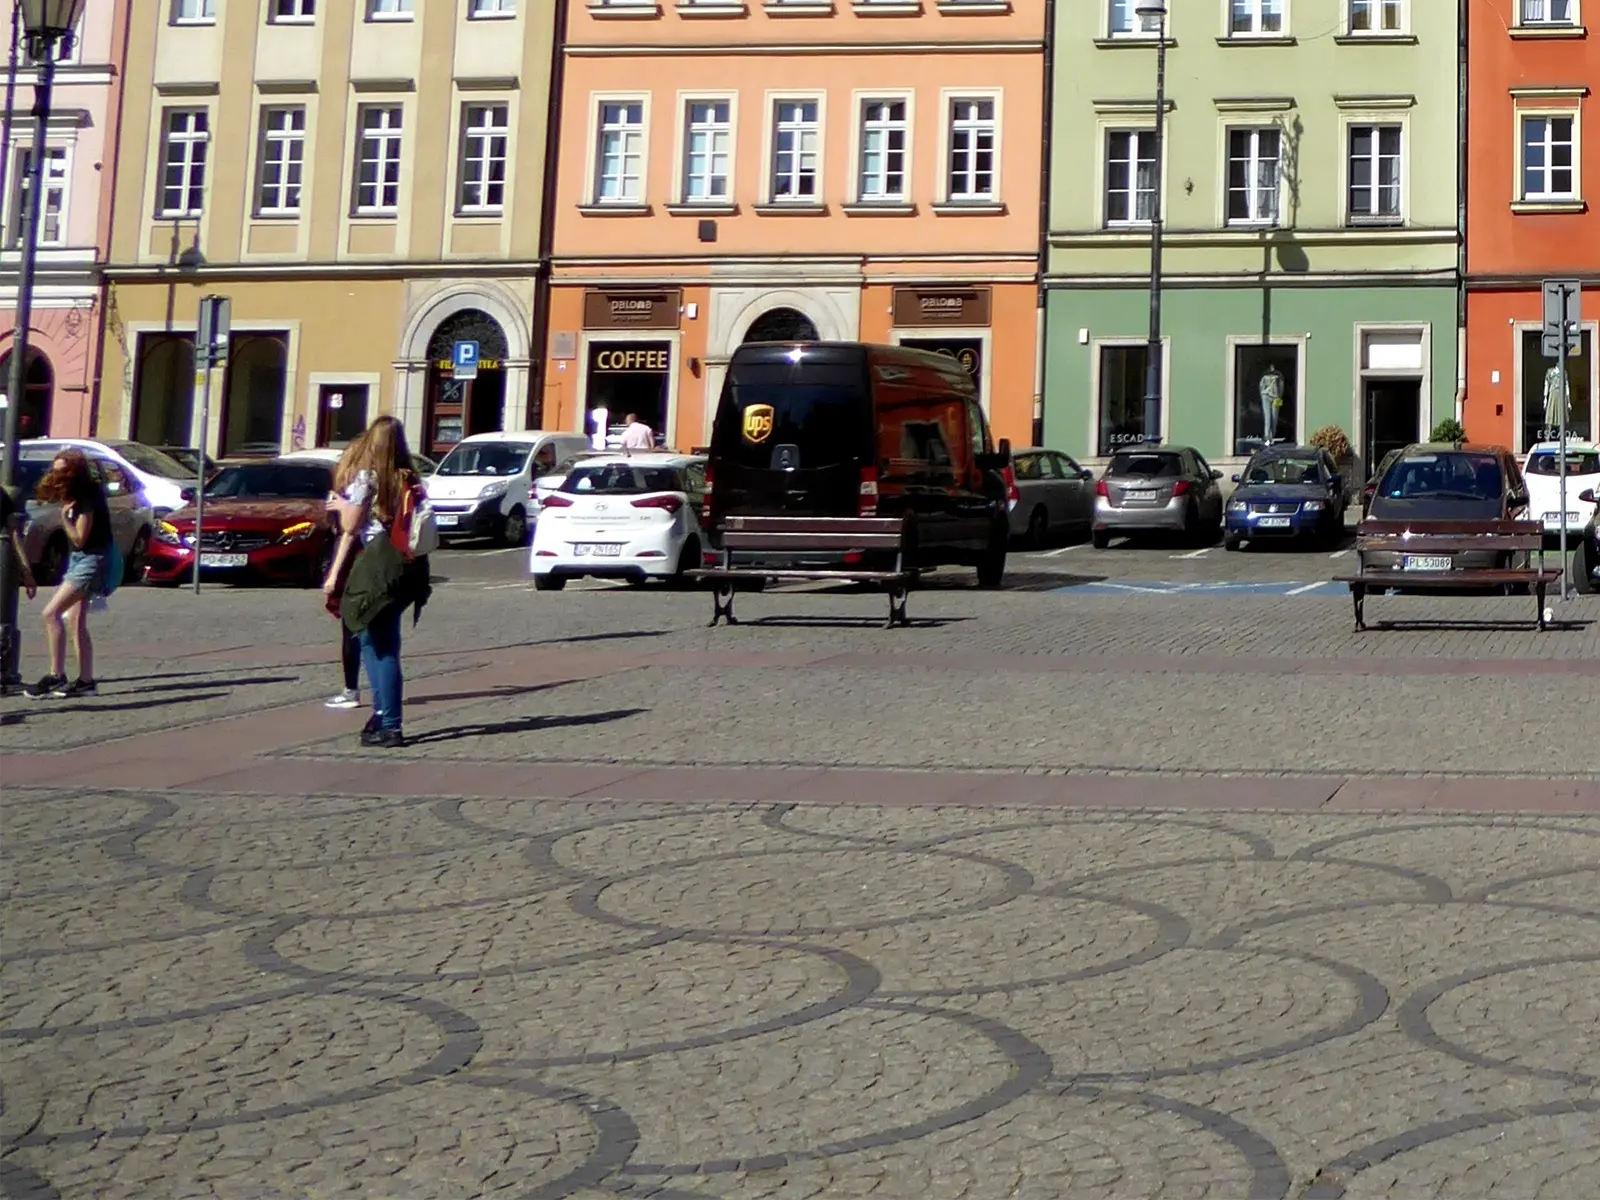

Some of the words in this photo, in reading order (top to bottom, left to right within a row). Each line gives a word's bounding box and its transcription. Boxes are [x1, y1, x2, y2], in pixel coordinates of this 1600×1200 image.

[460, 344, 474, 364] P
[597, 350, 668, 369] COFFEE
[1110, 433, 1146, 443] ESCAD
[1409, 557, 1422, 568] PL
